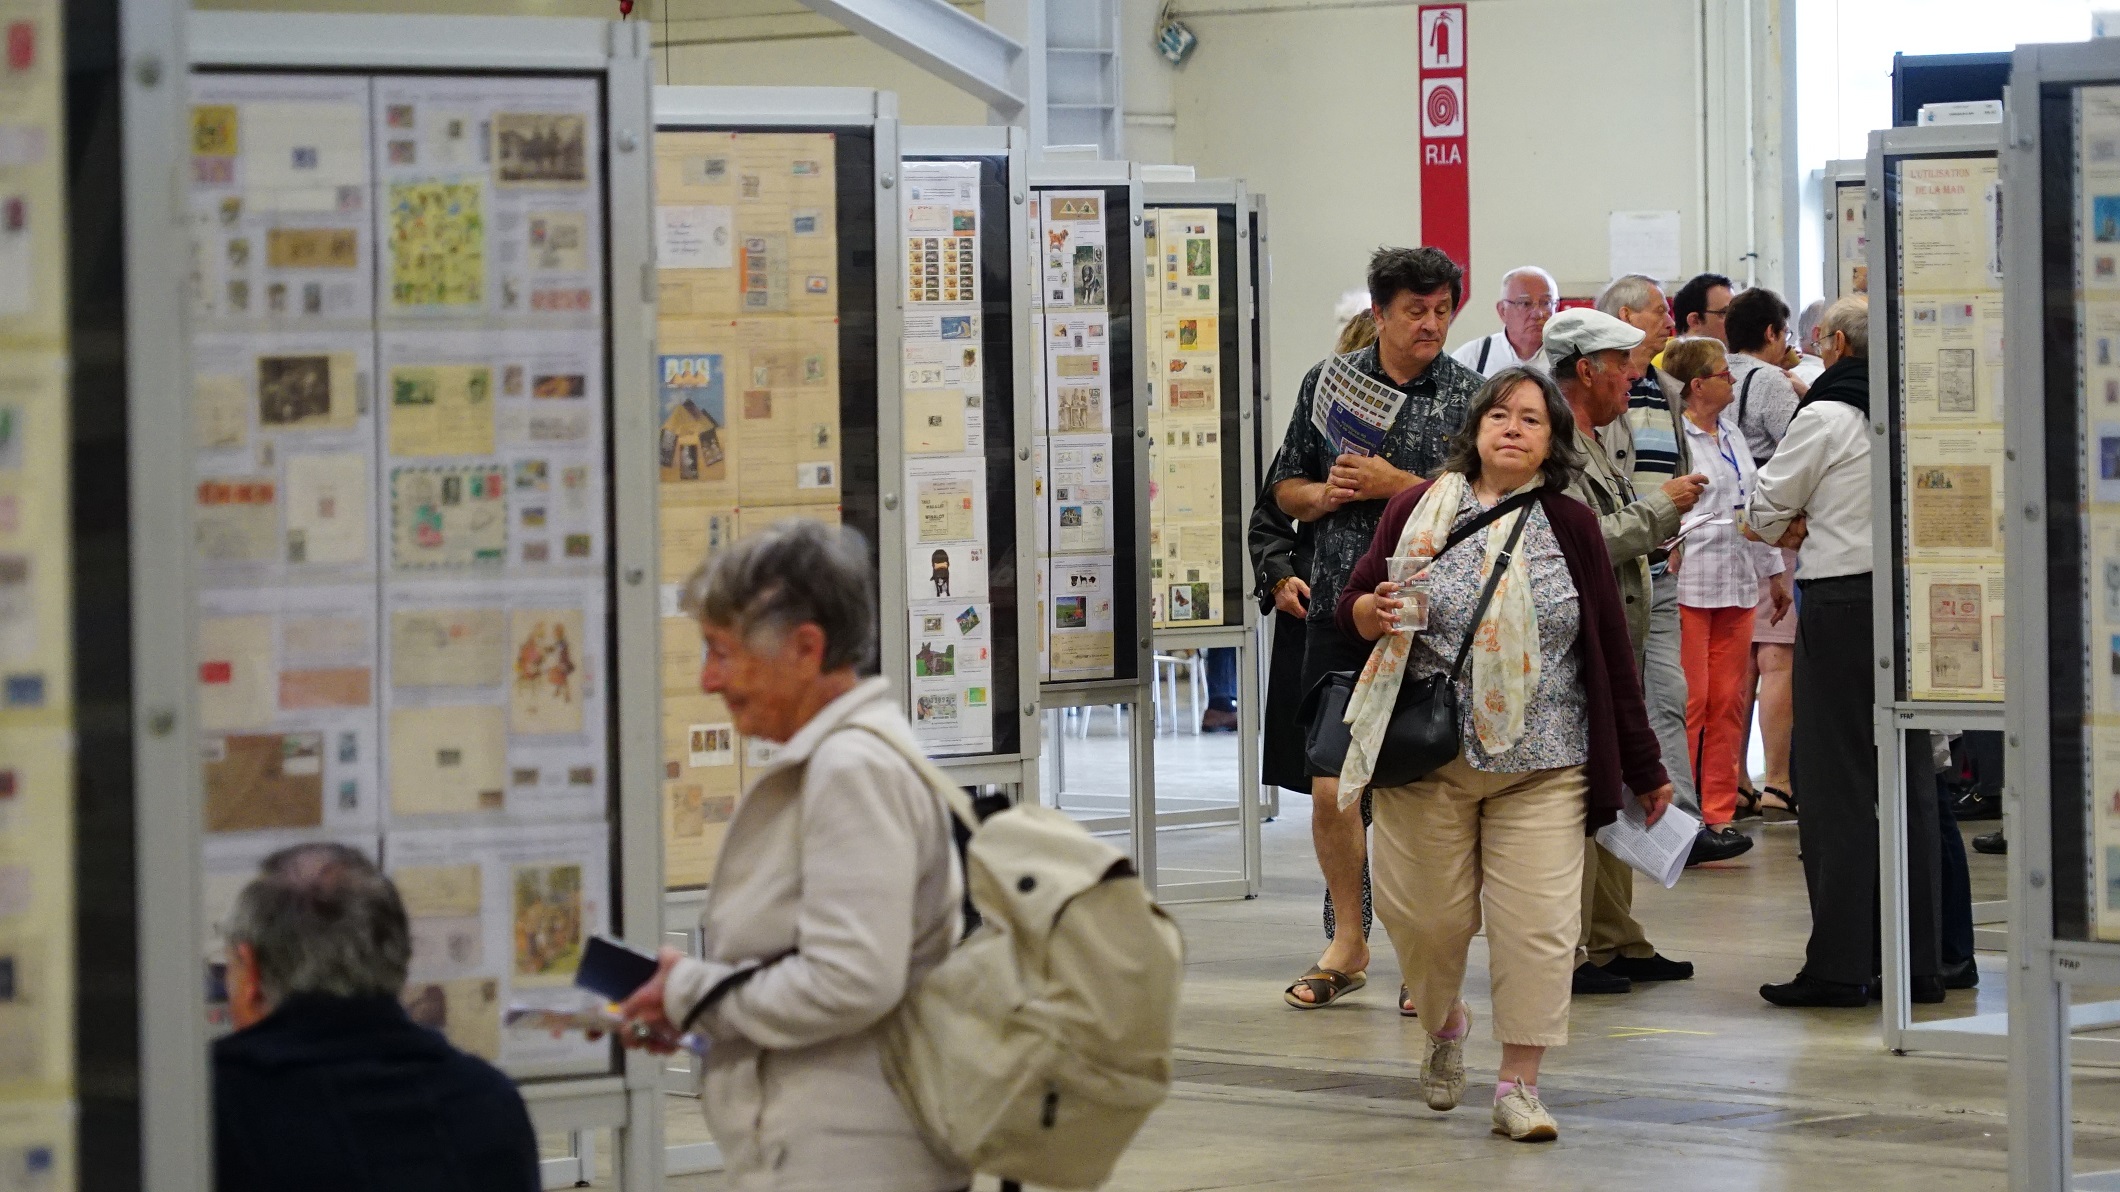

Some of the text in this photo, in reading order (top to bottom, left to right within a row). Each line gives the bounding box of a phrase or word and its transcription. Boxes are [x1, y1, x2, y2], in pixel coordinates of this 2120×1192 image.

[1915, 184, 1965, 195] DE LA MAIN
[2059, 958, 2081, 971] FFAP
